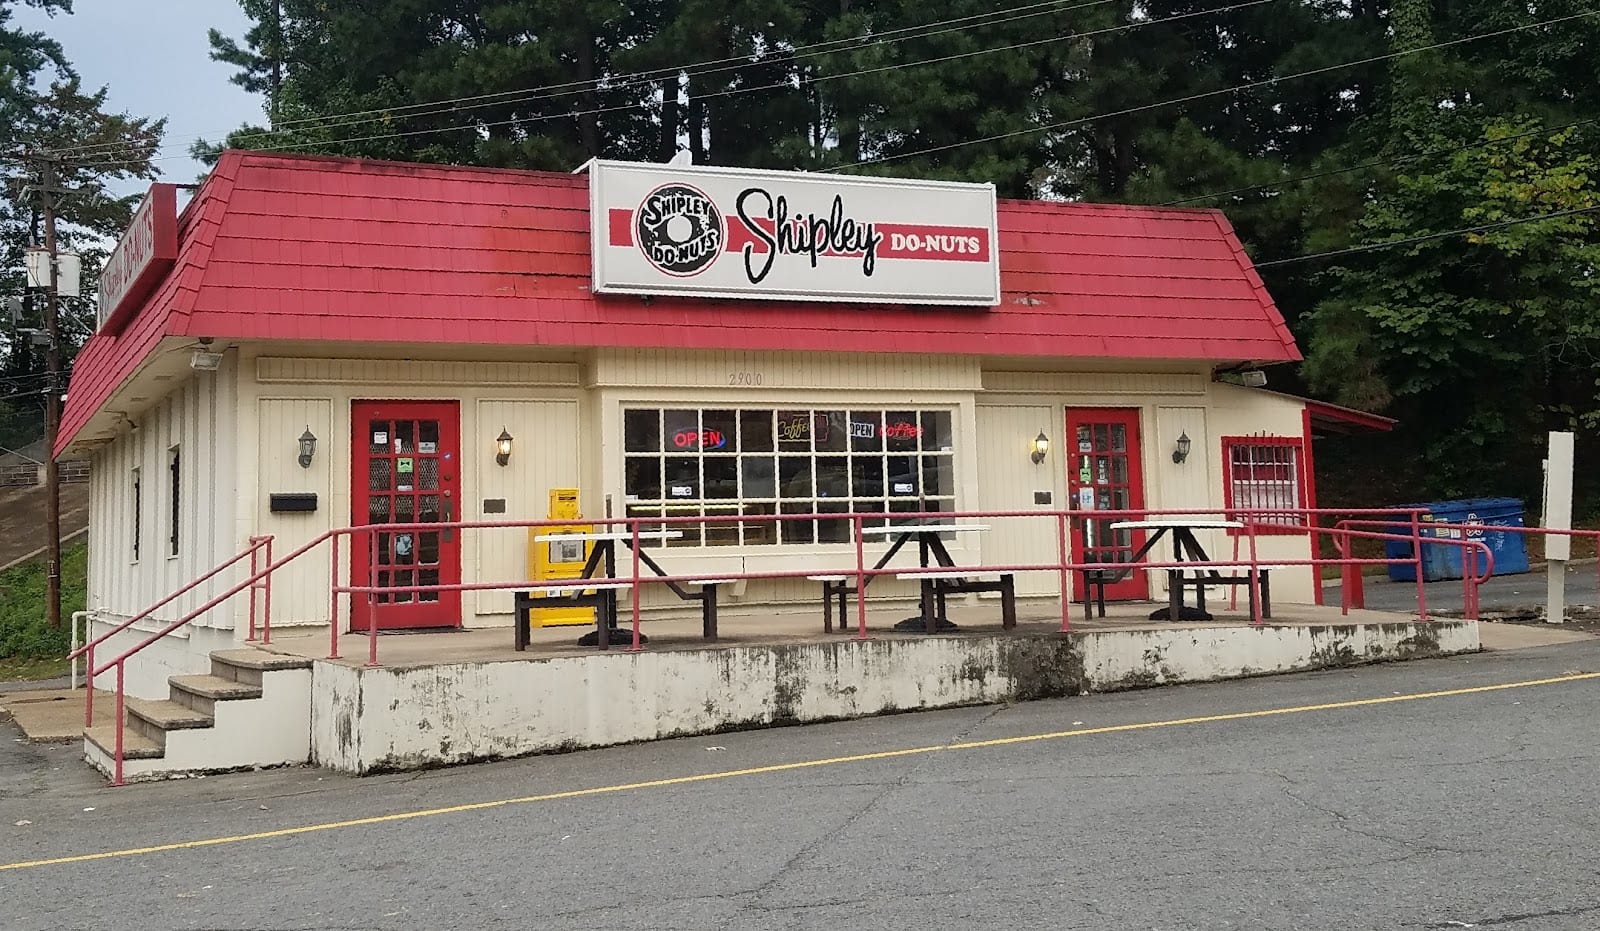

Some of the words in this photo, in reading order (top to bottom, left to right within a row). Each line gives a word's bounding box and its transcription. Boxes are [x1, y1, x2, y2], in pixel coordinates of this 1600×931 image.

[644, 195, 711, 225] SHIPLEY
[735, 187, 882, 284] Shipley
[890, 233, 980, 254] DO-NUTS
[728, 371, 762, 386] 2900
[673, 430, 721, 447] OPEN
